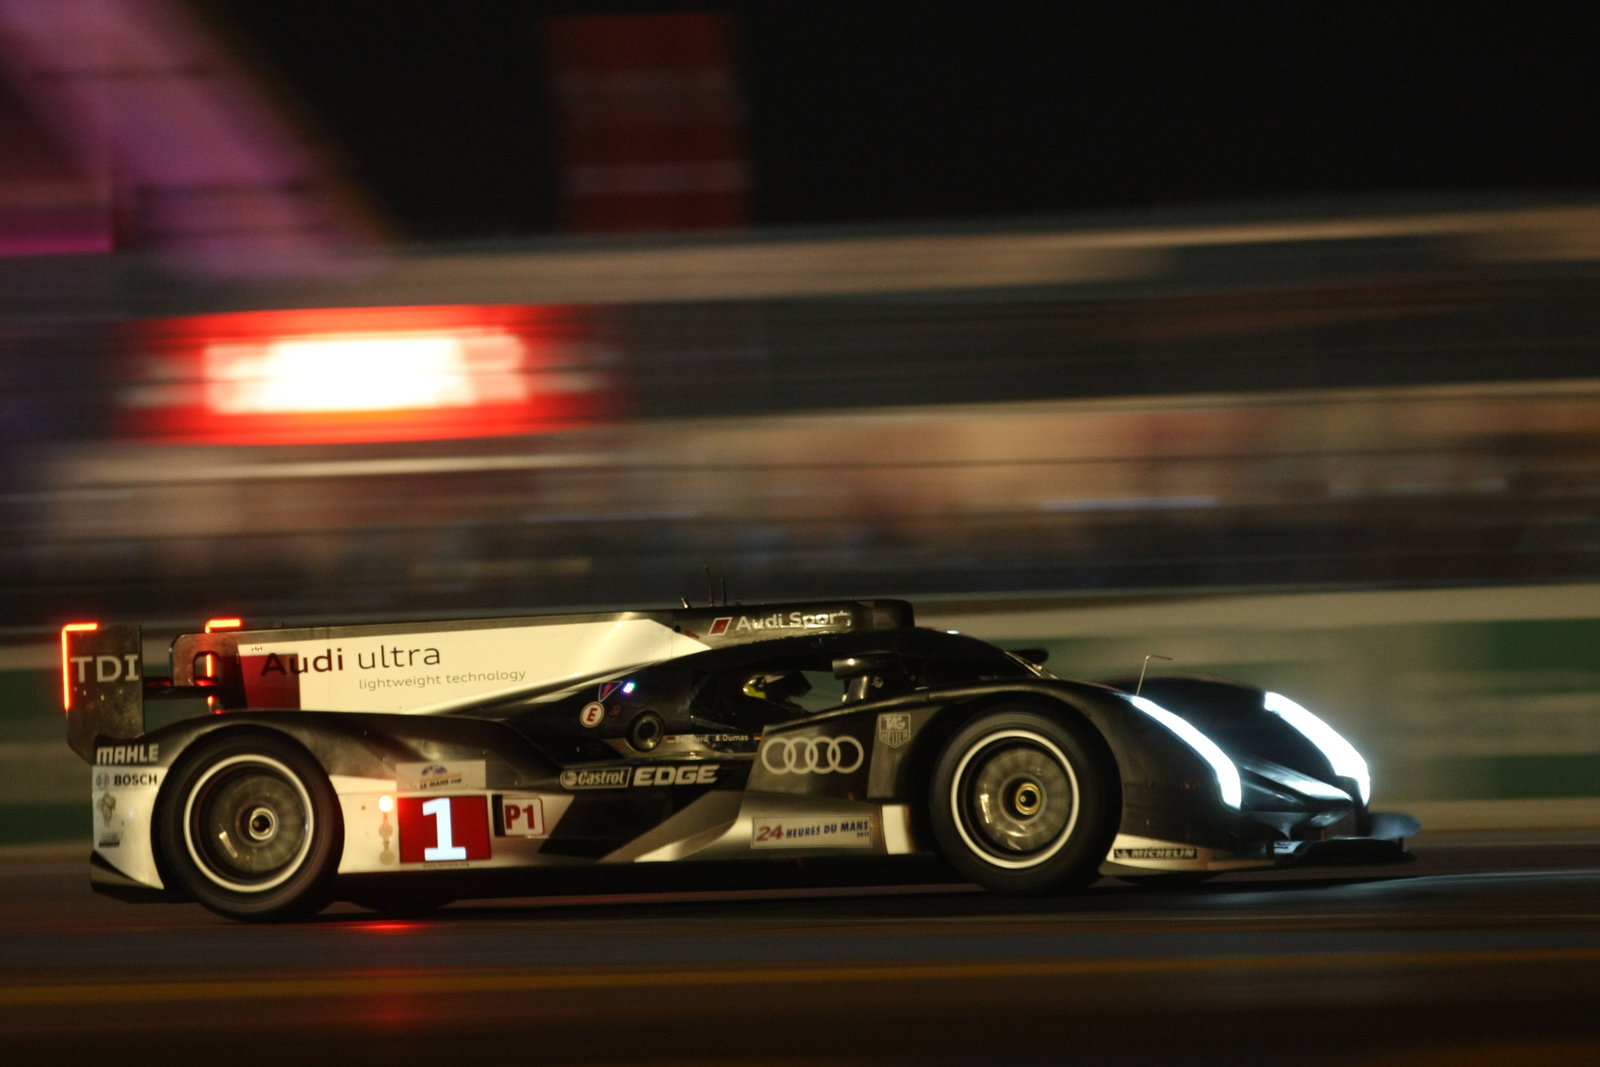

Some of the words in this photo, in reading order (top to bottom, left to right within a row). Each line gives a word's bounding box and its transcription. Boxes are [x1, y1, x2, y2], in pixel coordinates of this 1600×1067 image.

[736, 613, 784, 631] Audi
[789, 610, 850, 629] Sport
[70, 654, 140, 683] TDI
[260, 648, 344, 677] Audi
[357, 644, 441, 670] ultra
[358, 674, 441, 690] lightweight
[446, 670, 527, 684] technology
[586, 707, 597, 722] E
[885, 717, 906, 730] TAG
[722, 734, 749, 742] Dumas
[96, 744, 159, 764] MAHLE
[113, 774, 158, 786] BOSCH
[577, 770, 624, 786] Castrol
[633, 765, 720, 786] EDGE
[504, 804, 535, 830] P1
[422, 797, 467, 862] 1
[756, 825, 783, 842] 24
[786, 826, 821, 839] HEURES
[823, 824, 838, 834] DU
[840, 820, 869, 831] MANS
[1131, 848, 1196, 858] MICHELIN
